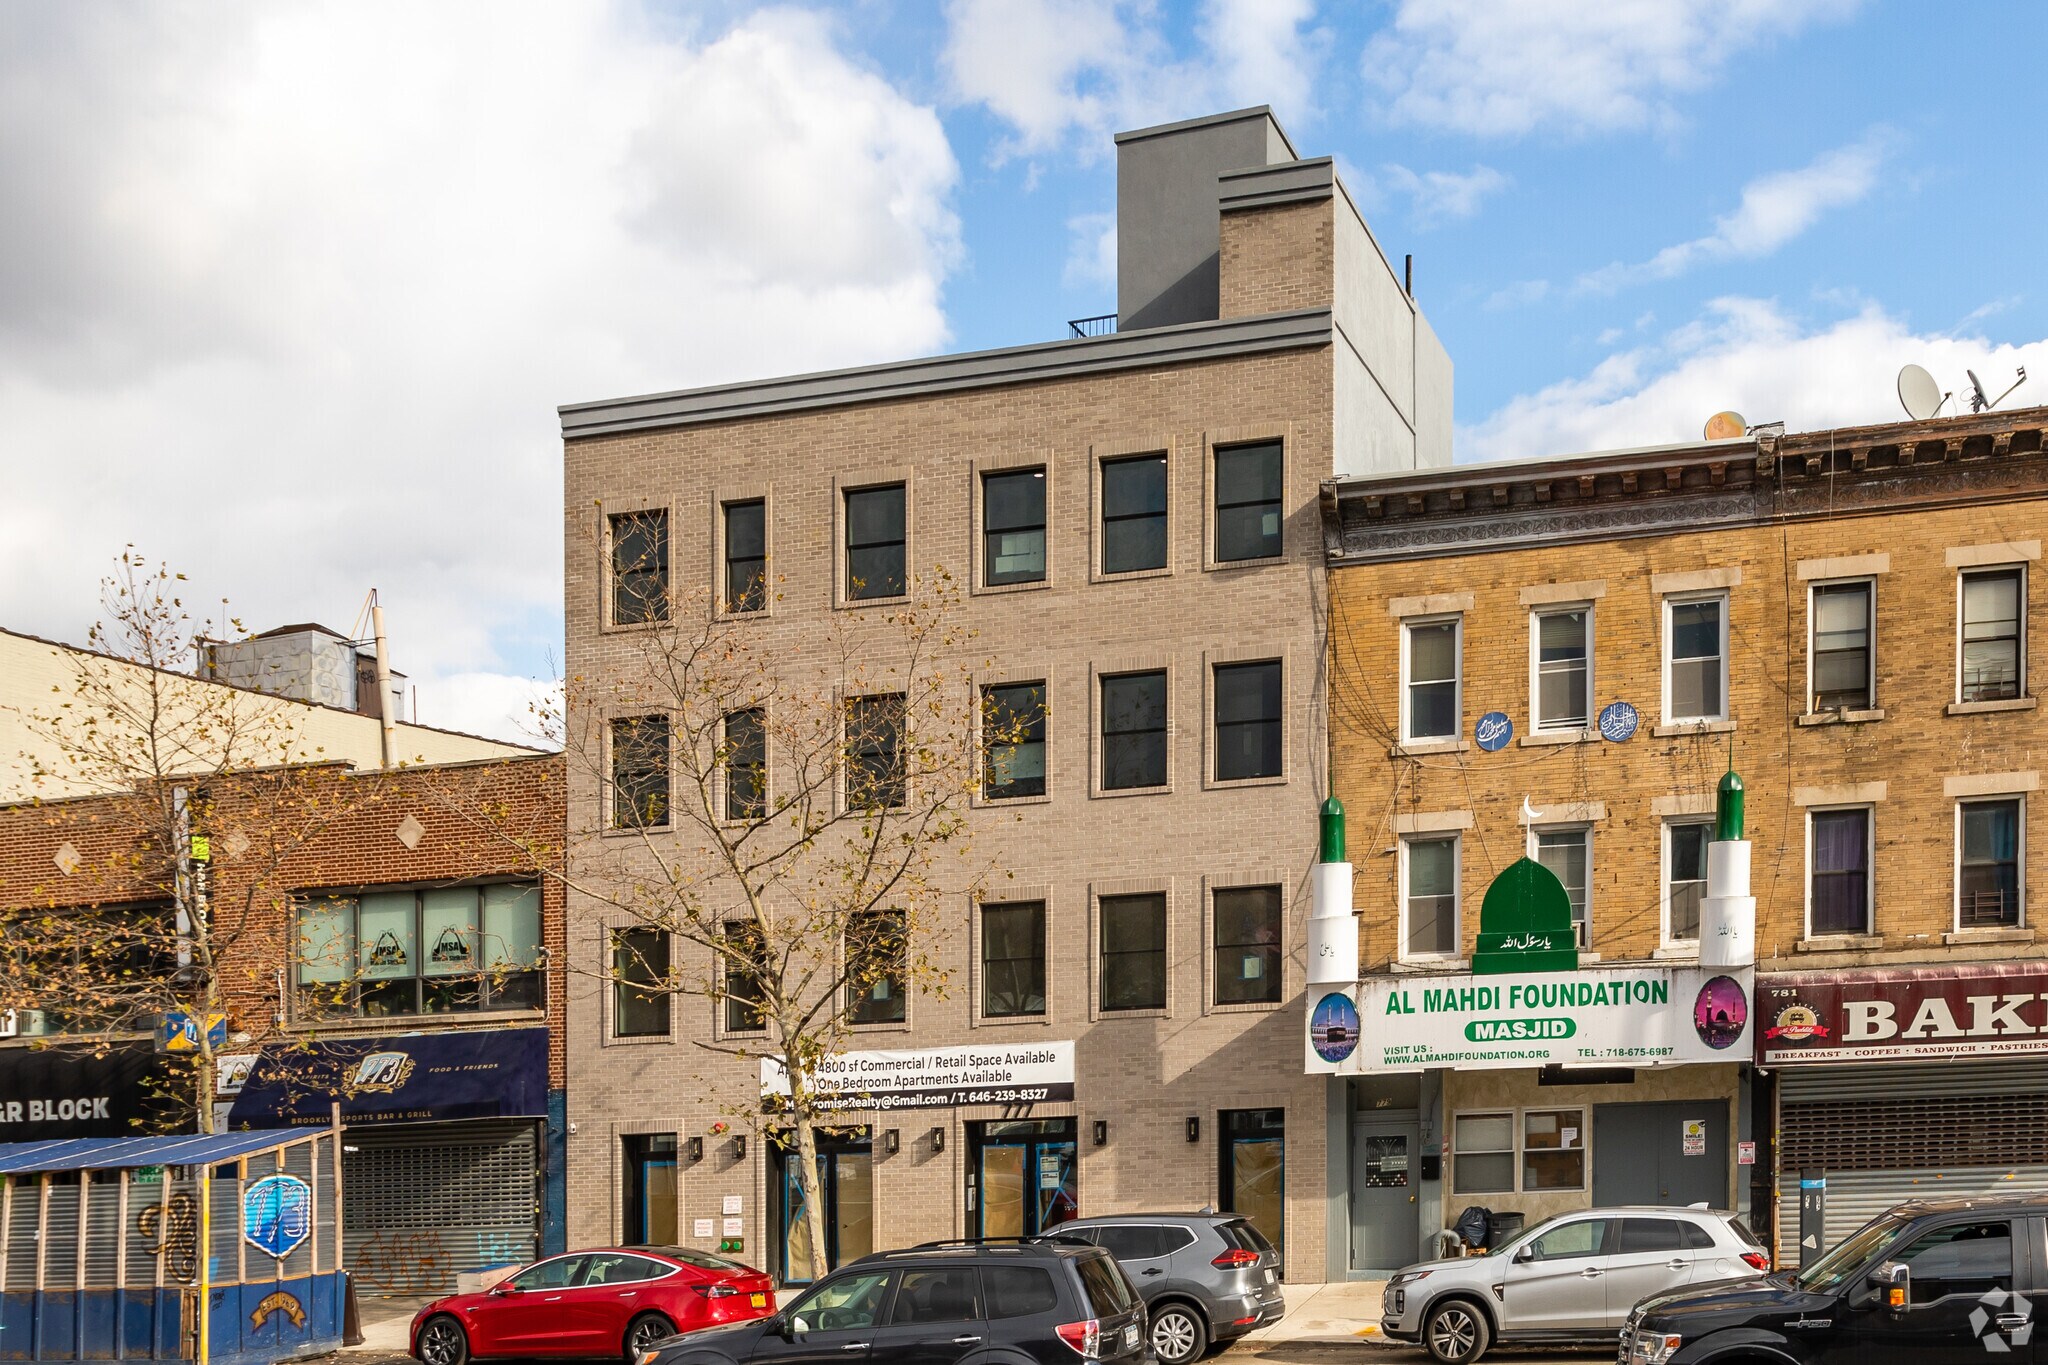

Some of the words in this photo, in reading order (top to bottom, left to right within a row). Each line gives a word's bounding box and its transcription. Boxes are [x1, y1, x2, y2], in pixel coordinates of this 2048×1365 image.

[441, 942, 459, 952] MSA
[1385, 991, 1416, 1015] AL
[1423, 986, 1500, 1013] MAHDI
[1509, 979, 1668, 1009] FOUNDATION
[1771, 988, 1798, 997] 781
[1475, 1020, 1568, 1039] MASJID
[1384, 1046, 1410, 1055] VISIT
[1413, 1045, 1427, 1053] US
[1384, 1050, 1550, 1065] WWW.ALMAHDIFOUNDATION.ORG
[1578, 1048, 1597, 1057] TEL
[1606, 1047, 1674, 1057] 718-675-6987
[1774, 1050, 1841, 1059] BREAKFAST
[1854, 1048, 1901, 1056] COFFEE
[1914, 1045, 1977, 1053] SANDWICH
[1990, 1042, 2048, 1051] PASTRIES
[463, 1063, 499, 1071] FRIENDS
[848, 1060, 858, 1072] sf
[861, 1055, 925, 1072] Commercial
[935, 1054, 966, 1068] Retail
[969, 1053, 1002, 1070] Space
[1005, 1050, 1056, 1065] Available
[361, 1057, 400, 1084] 773
[818, 1077, 840, 1090] One
[843, 1074, 892, 1089] Bedroom
[894, 1072, 959, 1090] Apartments
[962, 1069, 1012, 1084] Available
[958, 1092, 967, 1103] T.
[969, 1088, 1048, 1103] 646-239-8327
[29, 1097, 109, 1121] BLOCK
[291, 1116, 333, 1125] BROOKLY
[341, 1113, 373, 1121] SPORTS
[377, 1111, 394, 1120] BAR
[407, 1110, 433, 1118] GRILL
